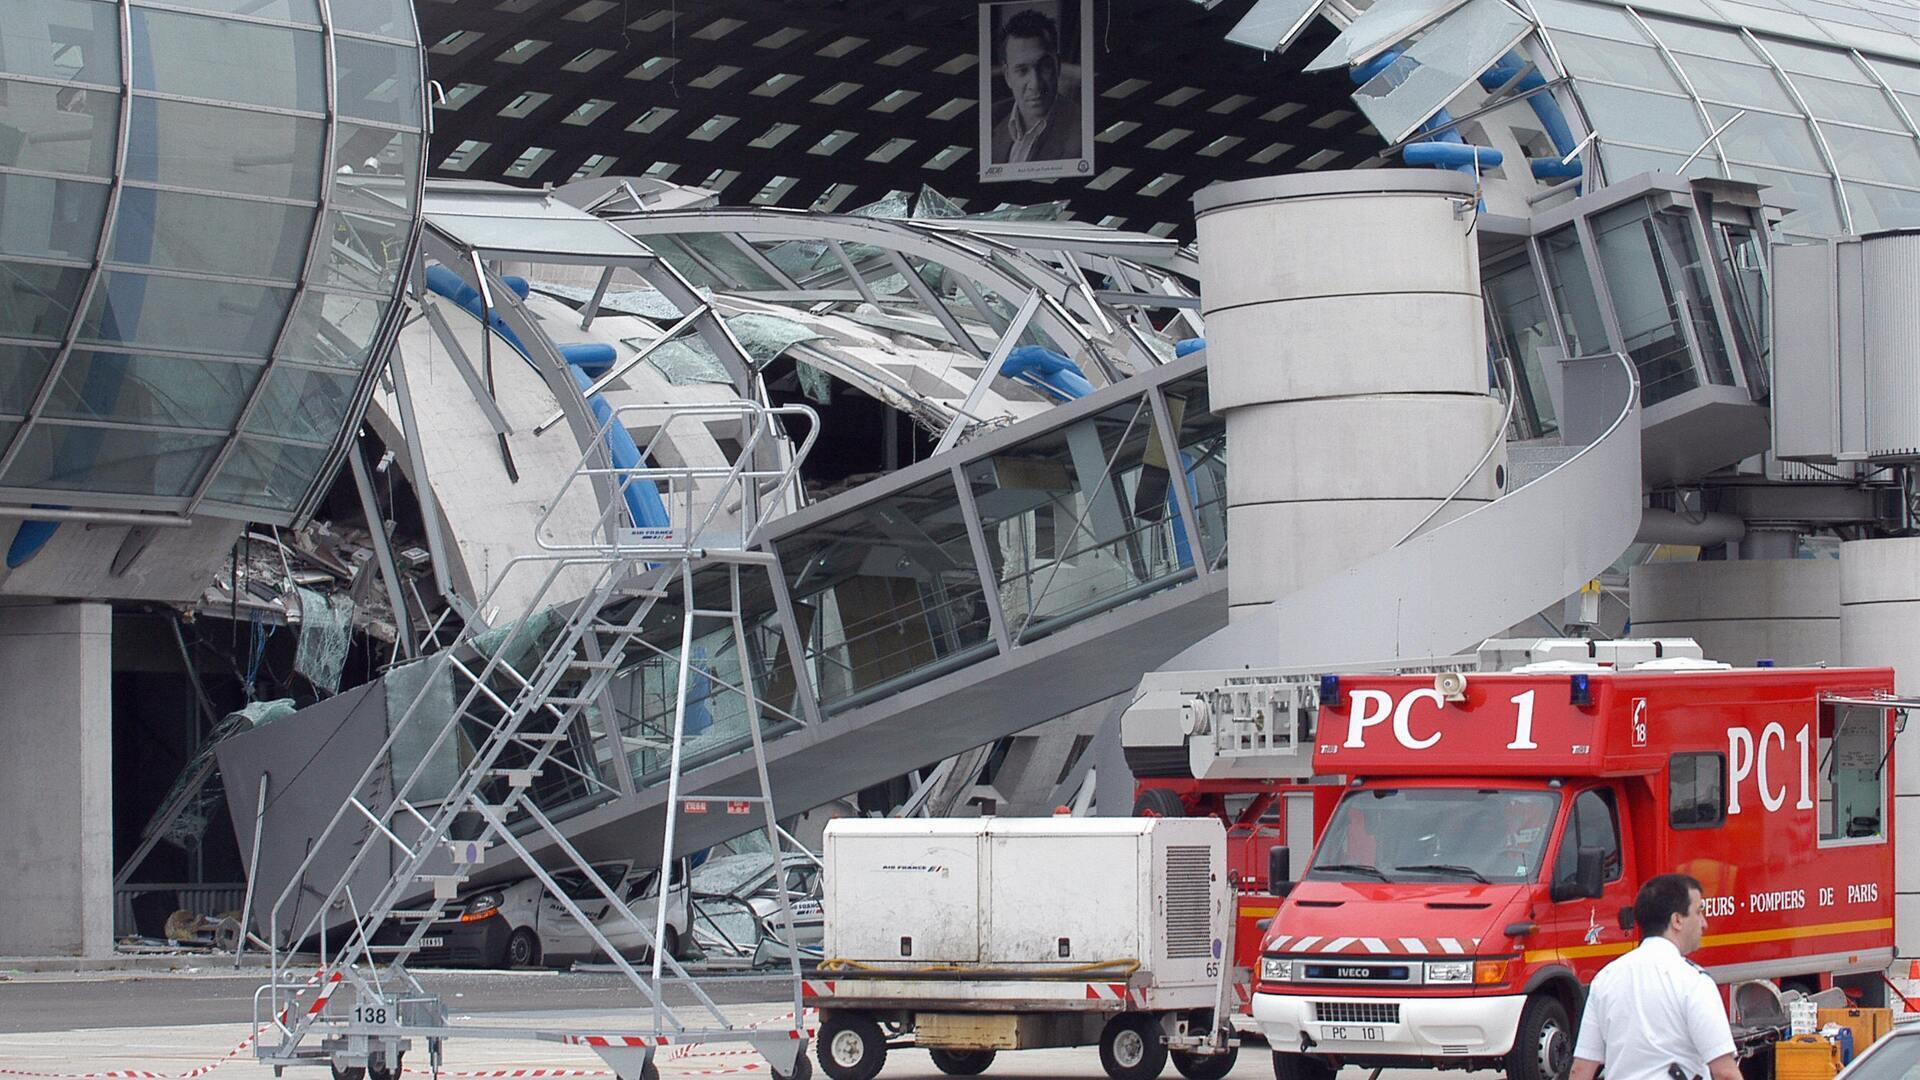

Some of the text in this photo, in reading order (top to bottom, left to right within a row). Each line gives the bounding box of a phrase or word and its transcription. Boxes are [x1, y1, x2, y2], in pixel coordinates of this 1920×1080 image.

[1343, 688, 1538, 749] PC 1
[1635, 723, 1646, 742] 18
[1750, 889, 1806, 913] POMPIERS
[1819, 887, 1834, 907] DE
[1848, 883, 1878, 903] PARIS
[1338, 967, 1370, 977] IVECO
[355, 1007, 386, 1024] 138
[1332, 1027, 1375, 1039] PC 10
